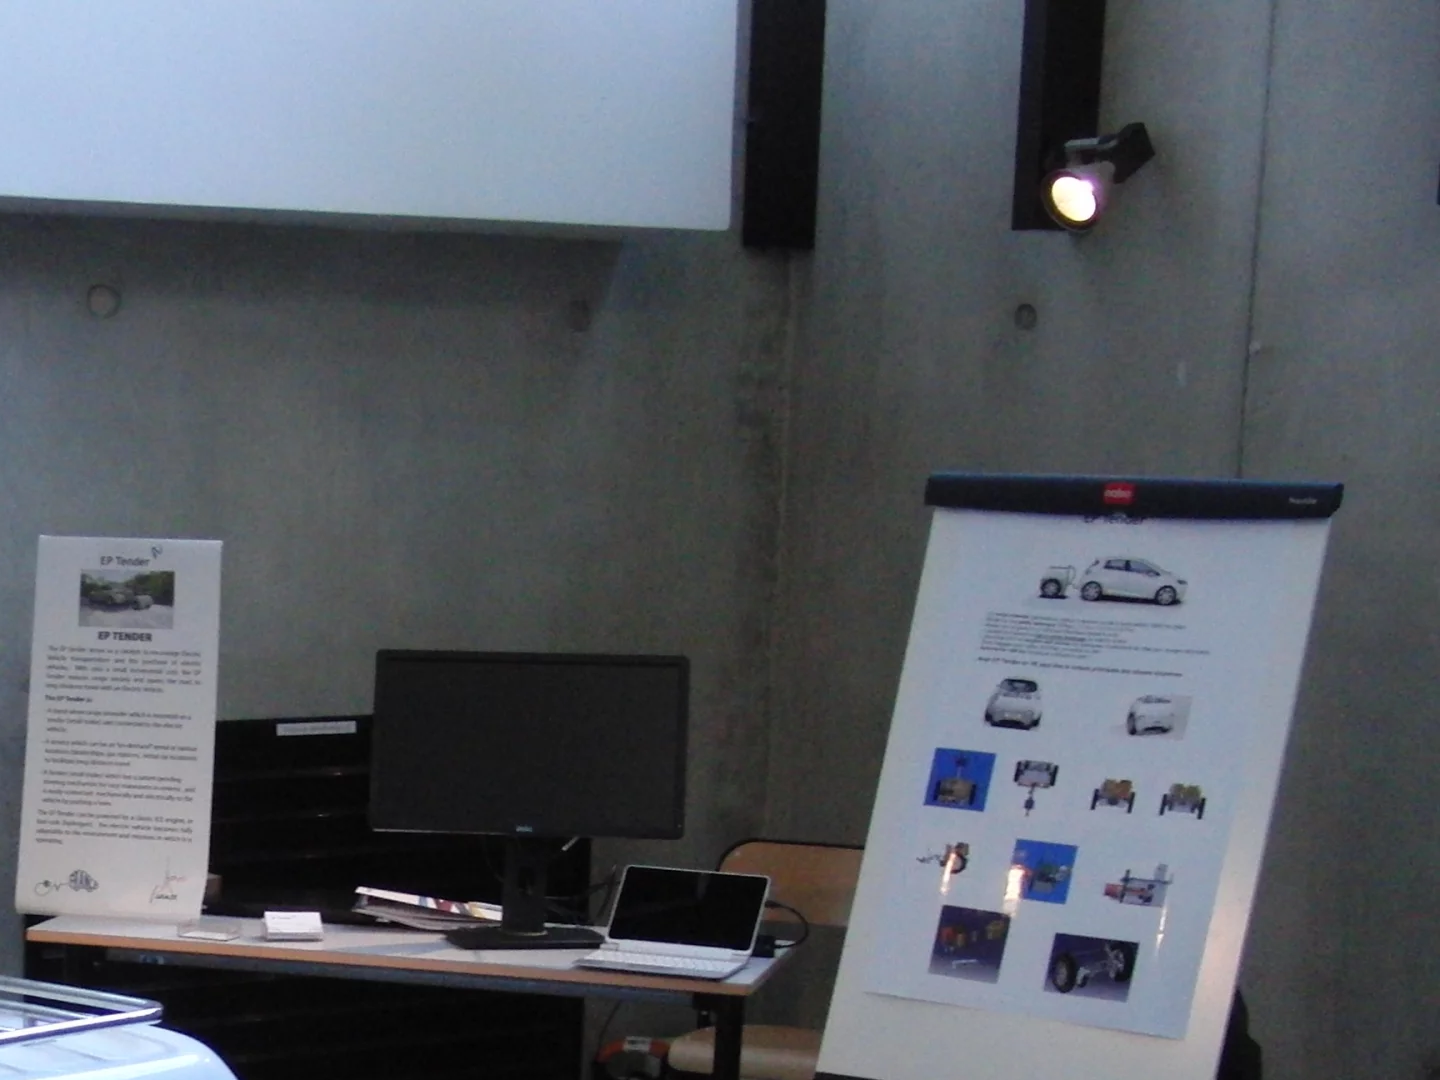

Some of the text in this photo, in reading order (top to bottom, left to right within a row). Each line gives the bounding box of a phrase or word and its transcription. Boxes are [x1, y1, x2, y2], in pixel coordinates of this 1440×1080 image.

[100, 555, 151, 567] EP Tender
[97, 631, 153, 642] EP TENDER
